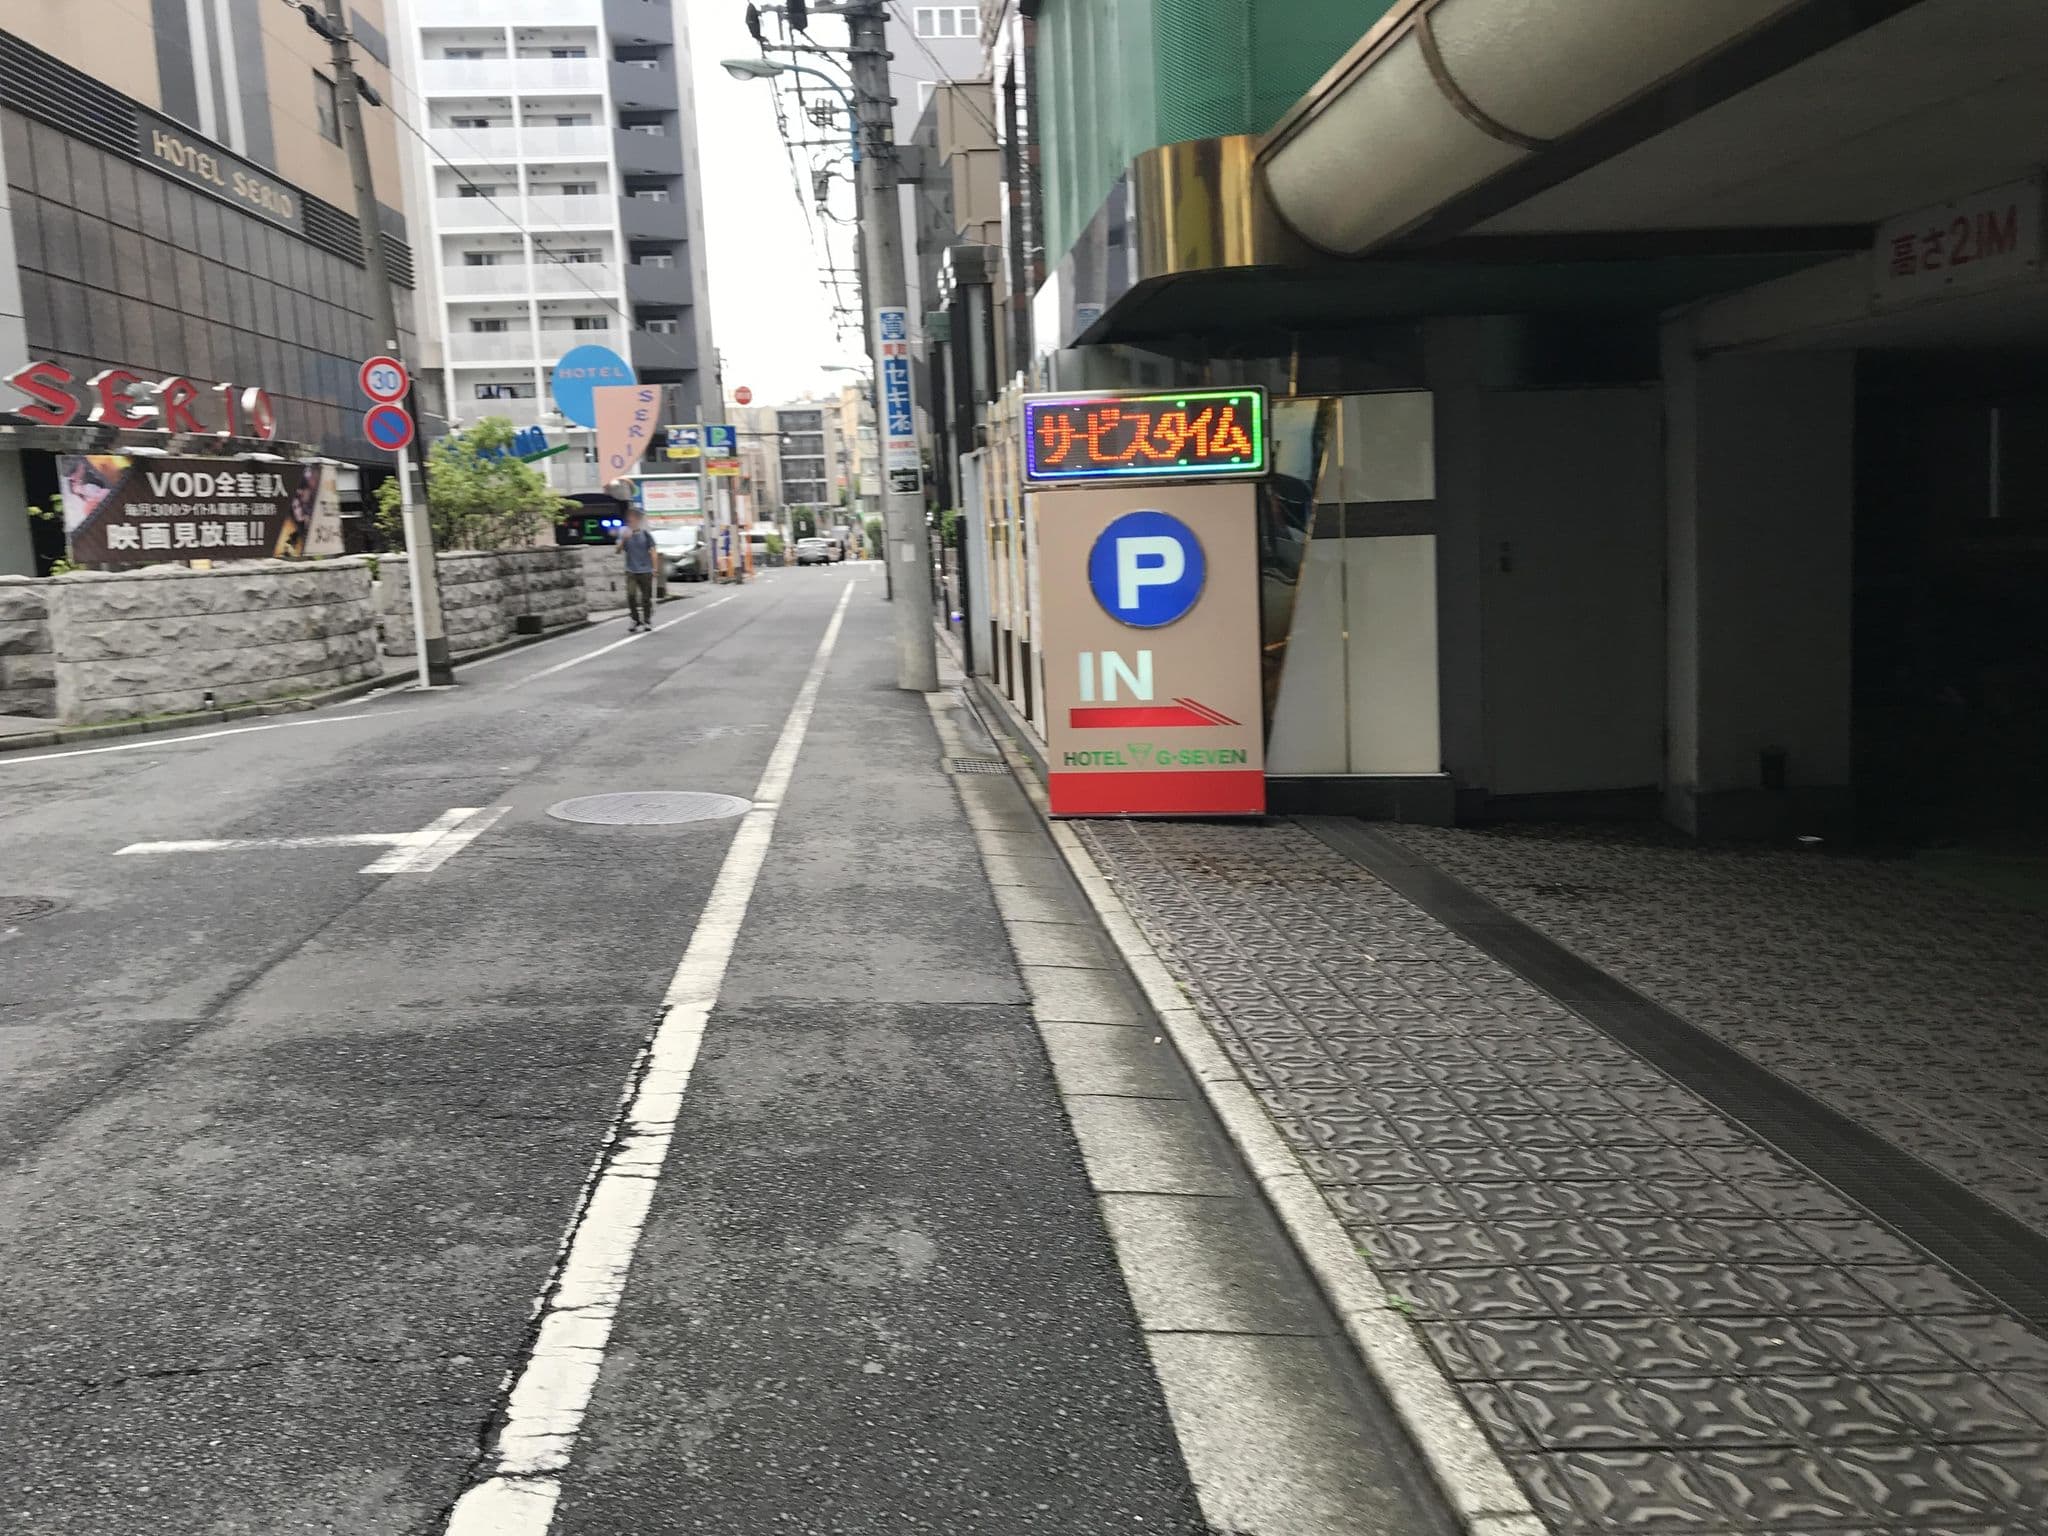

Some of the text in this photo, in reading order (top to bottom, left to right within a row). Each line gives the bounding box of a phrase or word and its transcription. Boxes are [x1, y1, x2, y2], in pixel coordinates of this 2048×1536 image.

[152, 130, 294, 219] HOTEL SERIO
[3, 361, 276, 440] SERIO
[371, 370, 398, 391] 30
[558, 367, 625, 379] HOTEL
[885, 362, 912, 432] セキネ
[610, 389, 655, 469] SERIO
[146, 471, 289, 498] VOD全室導入
[1115, 535, 1186, 610] P
[1078, 649, 1154, 701] IN
[1063, 751, 1128, 767] HOTEL
